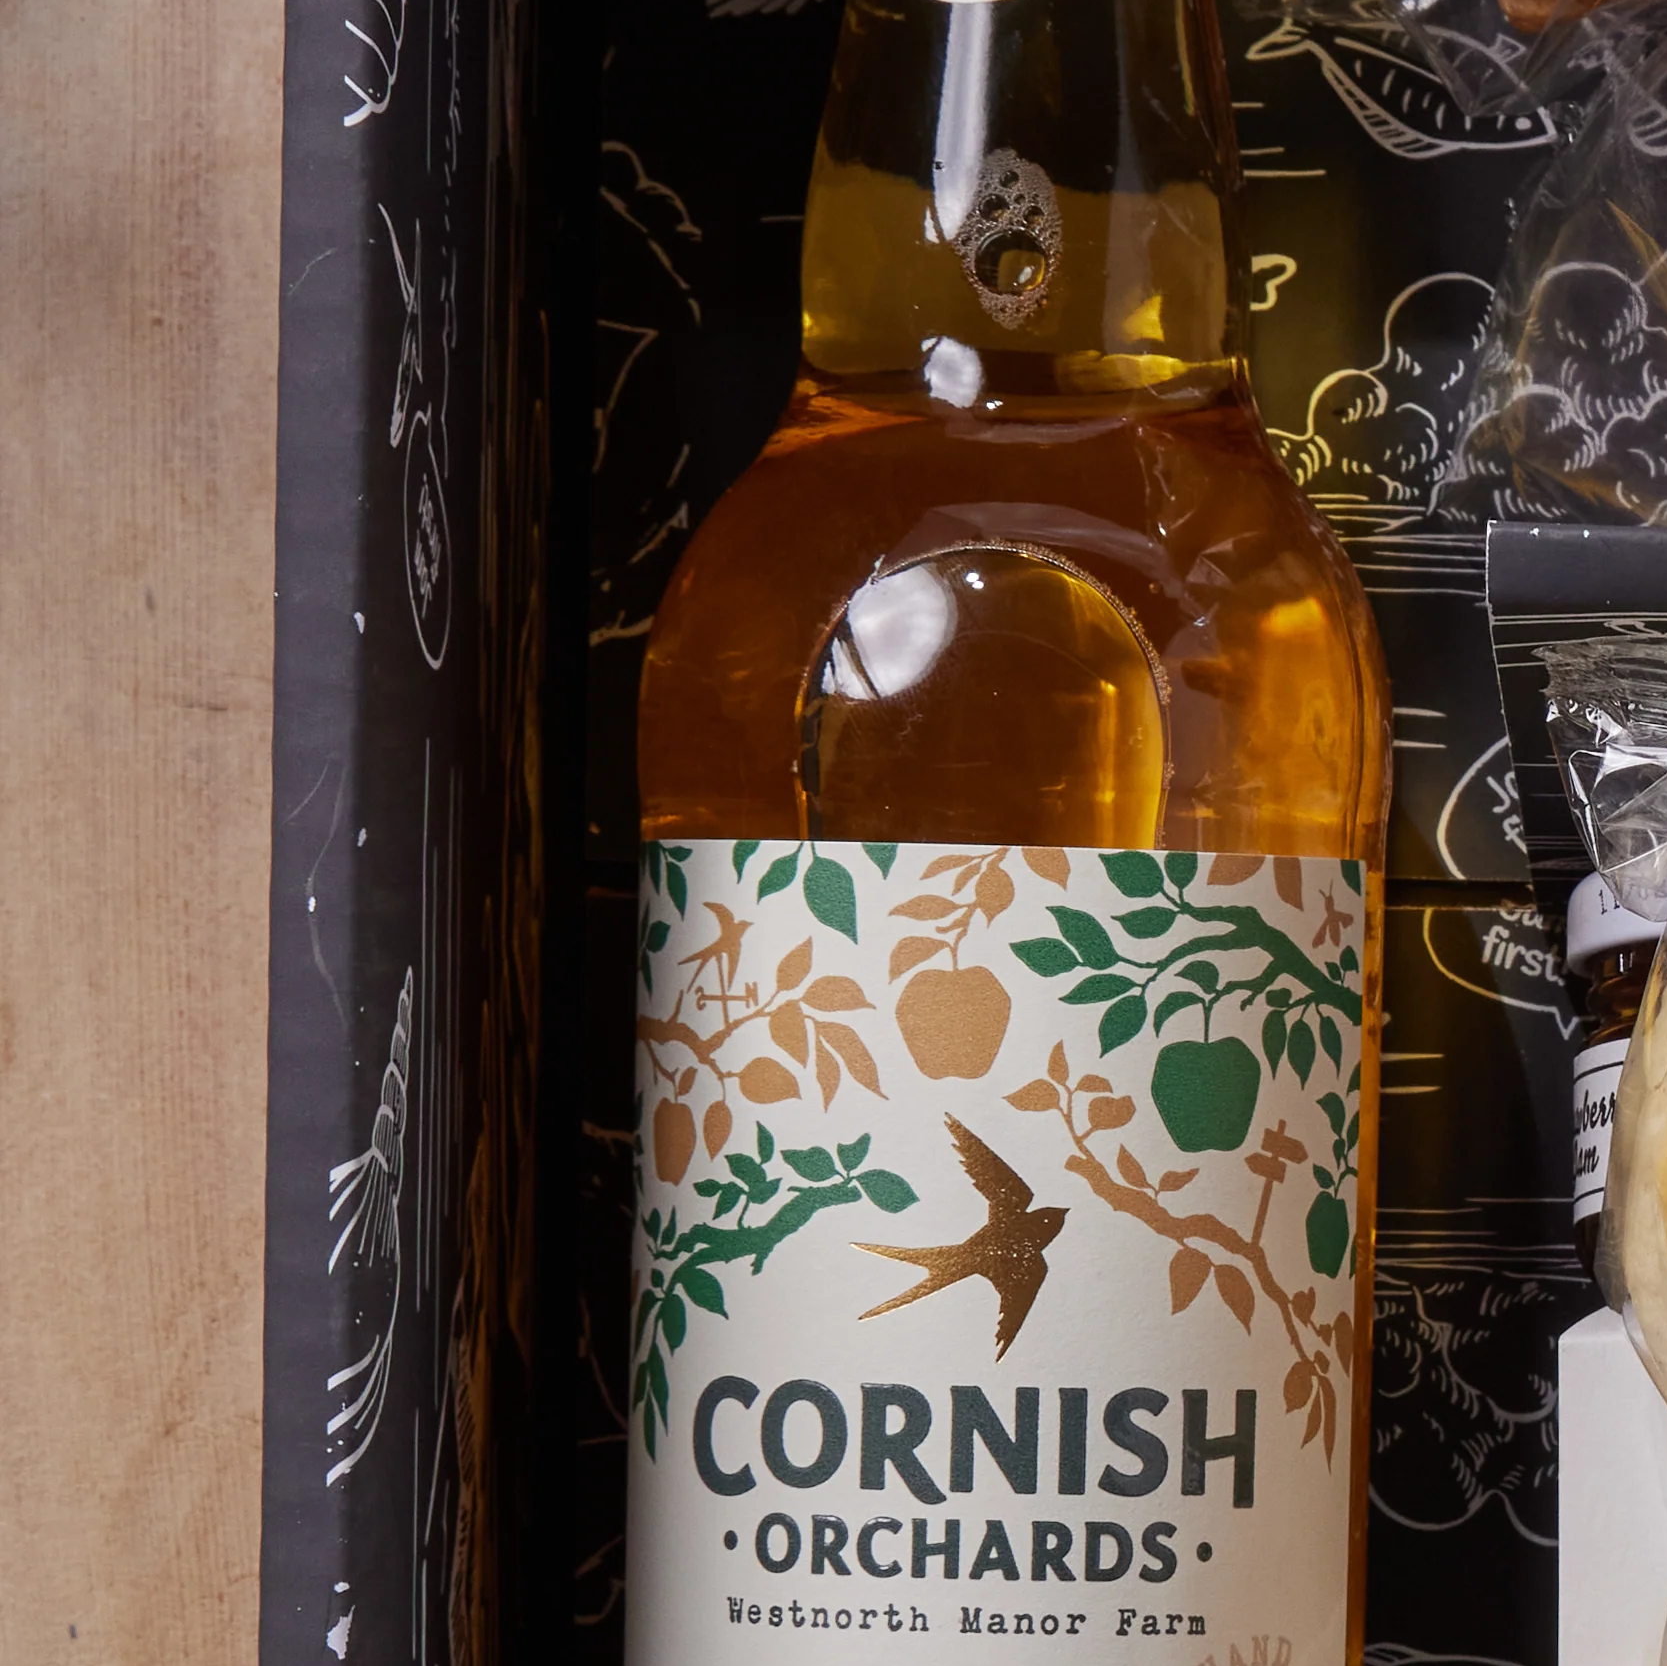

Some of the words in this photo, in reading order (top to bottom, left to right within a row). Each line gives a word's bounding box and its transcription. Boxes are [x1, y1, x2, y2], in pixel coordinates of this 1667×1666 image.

[692, 1375, 1258, 1508] CORNISH
[754, 1513, 1178, 1583] ORCHARDS
[727, 1596, 930, 1632] Westnorth
[959, 1605, 1087, 1636] Manor
[1116, 1608, 1208, 1636] Farm
